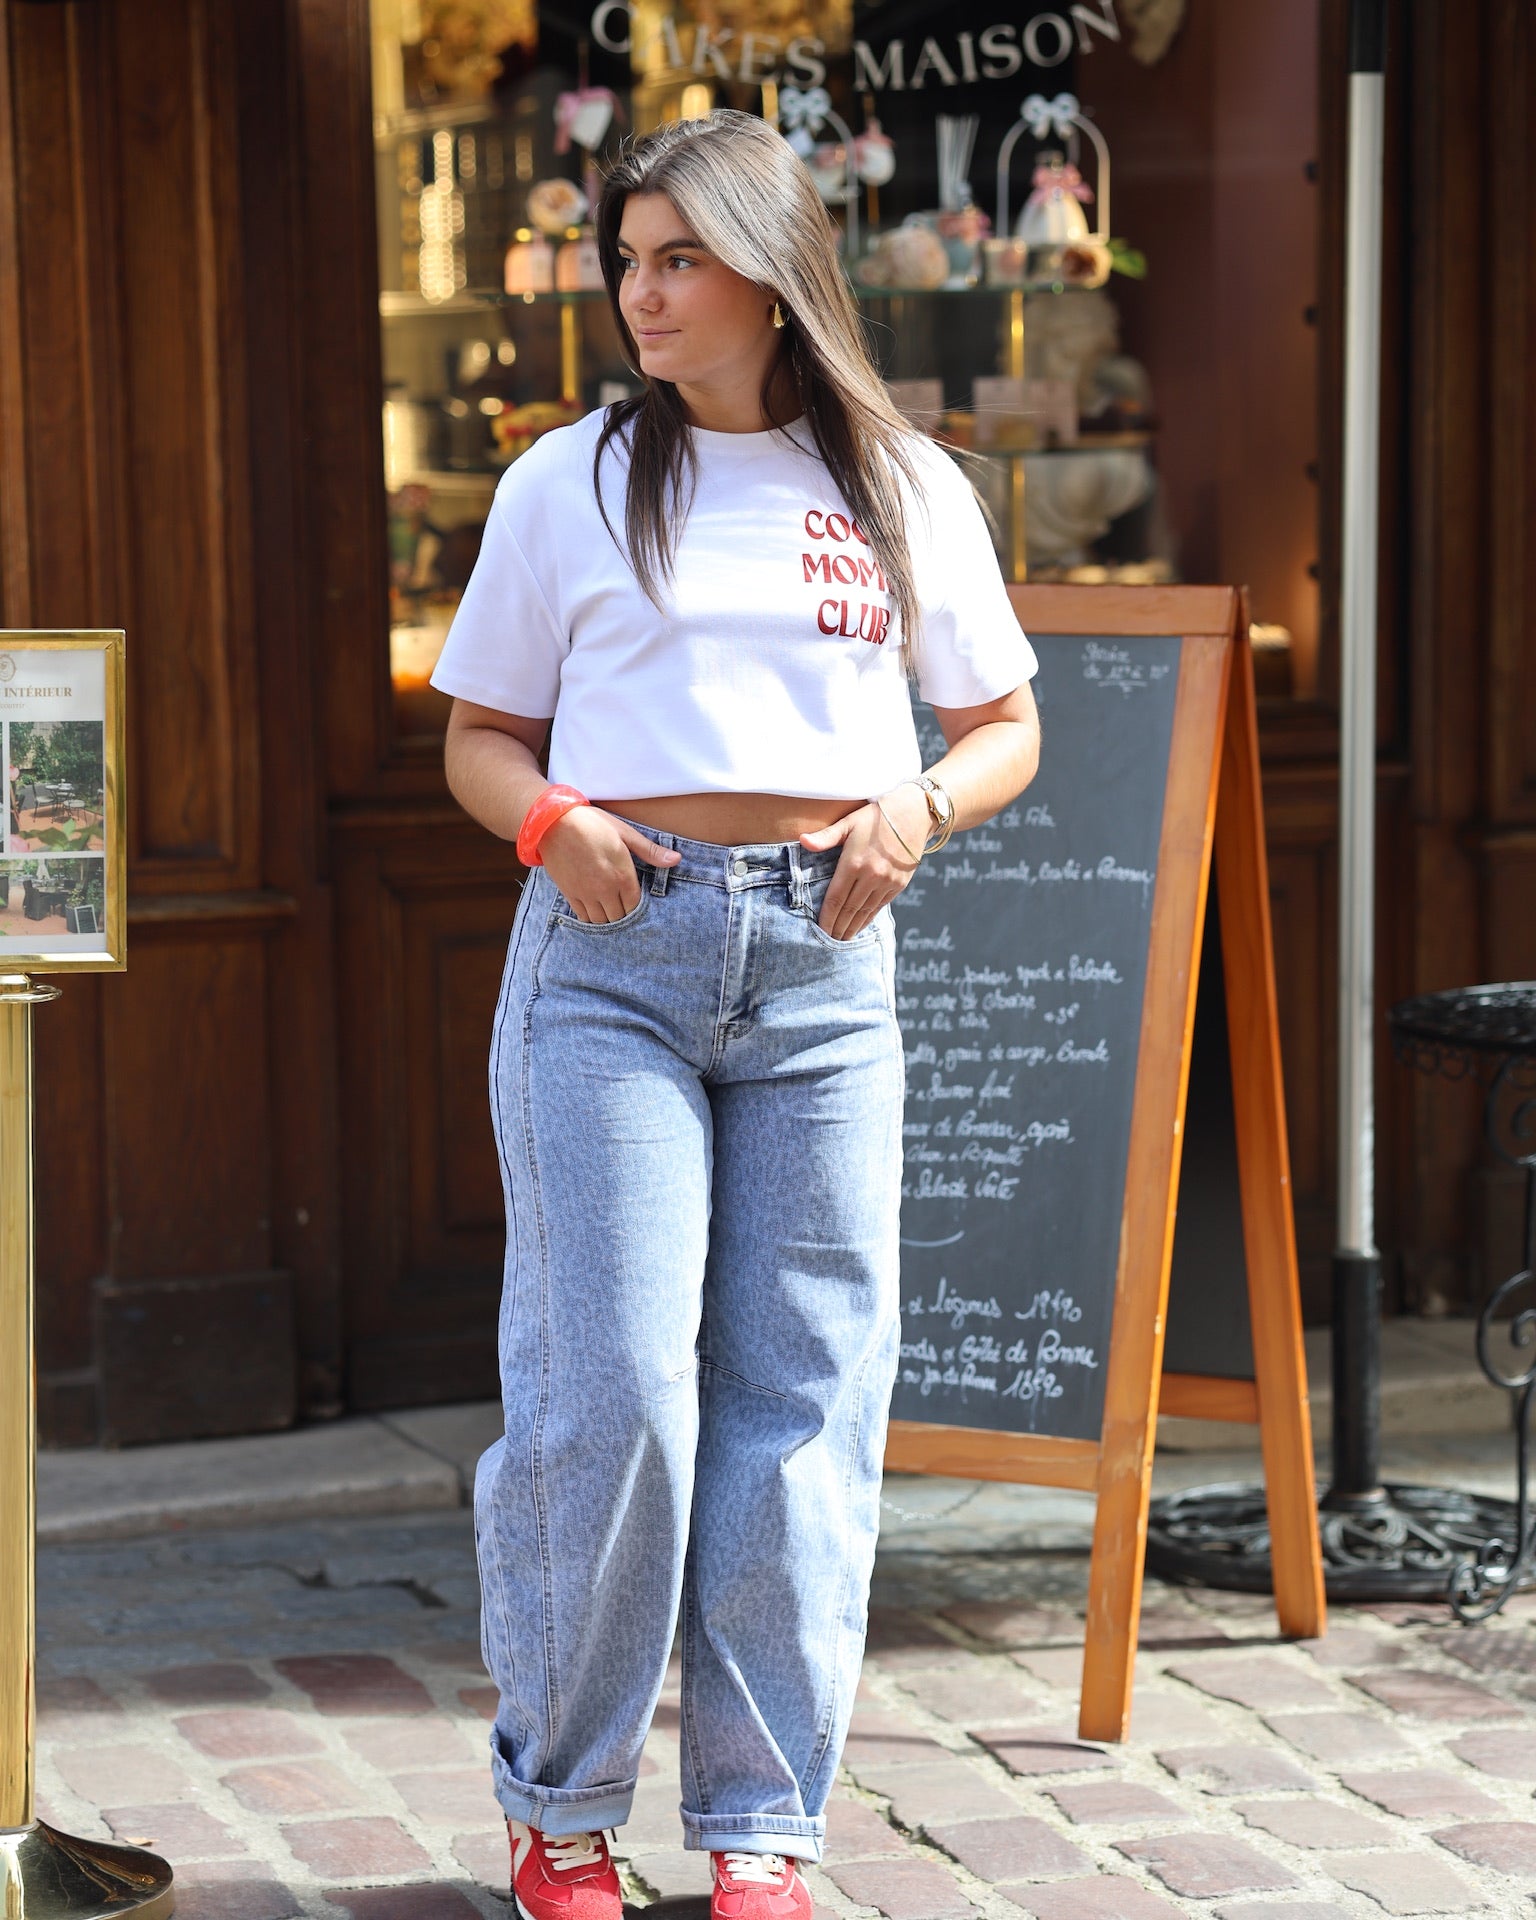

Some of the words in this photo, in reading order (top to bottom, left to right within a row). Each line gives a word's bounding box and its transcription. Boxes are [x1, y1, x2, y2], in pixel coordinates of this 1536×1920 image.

[590, 0, 826, 90] CAKES
[853, 0, 1121, 92] MAISON
[805, 510, 870, 545] CO
[817, 599, 891, 645] CLUB
[4, 685, 72, 697] INTÉRIEUR
